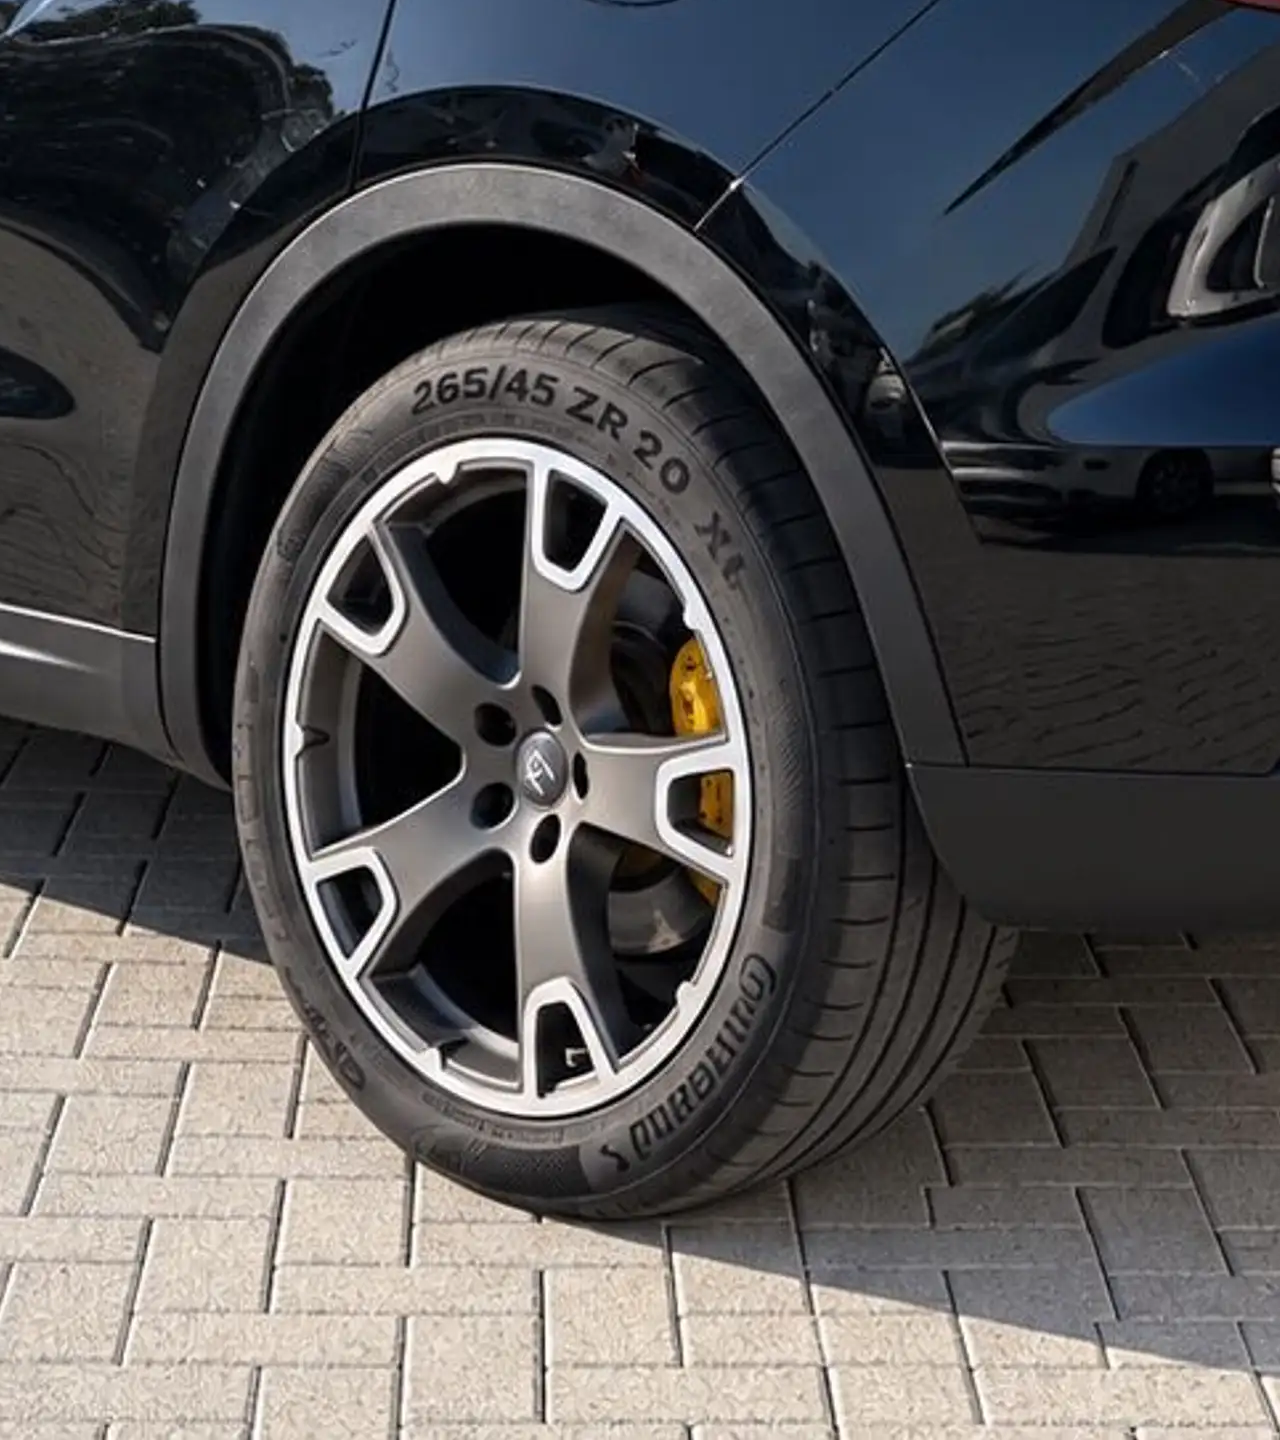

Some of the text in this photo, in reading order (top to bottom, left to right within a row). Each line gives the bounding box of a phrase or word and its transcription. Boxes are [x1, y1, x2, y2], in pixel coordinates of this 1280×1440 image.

[411, 364, 557, 417] 265/45
[564, 386, 630, 444] ZR
[633, 431, 691, 494] 20
